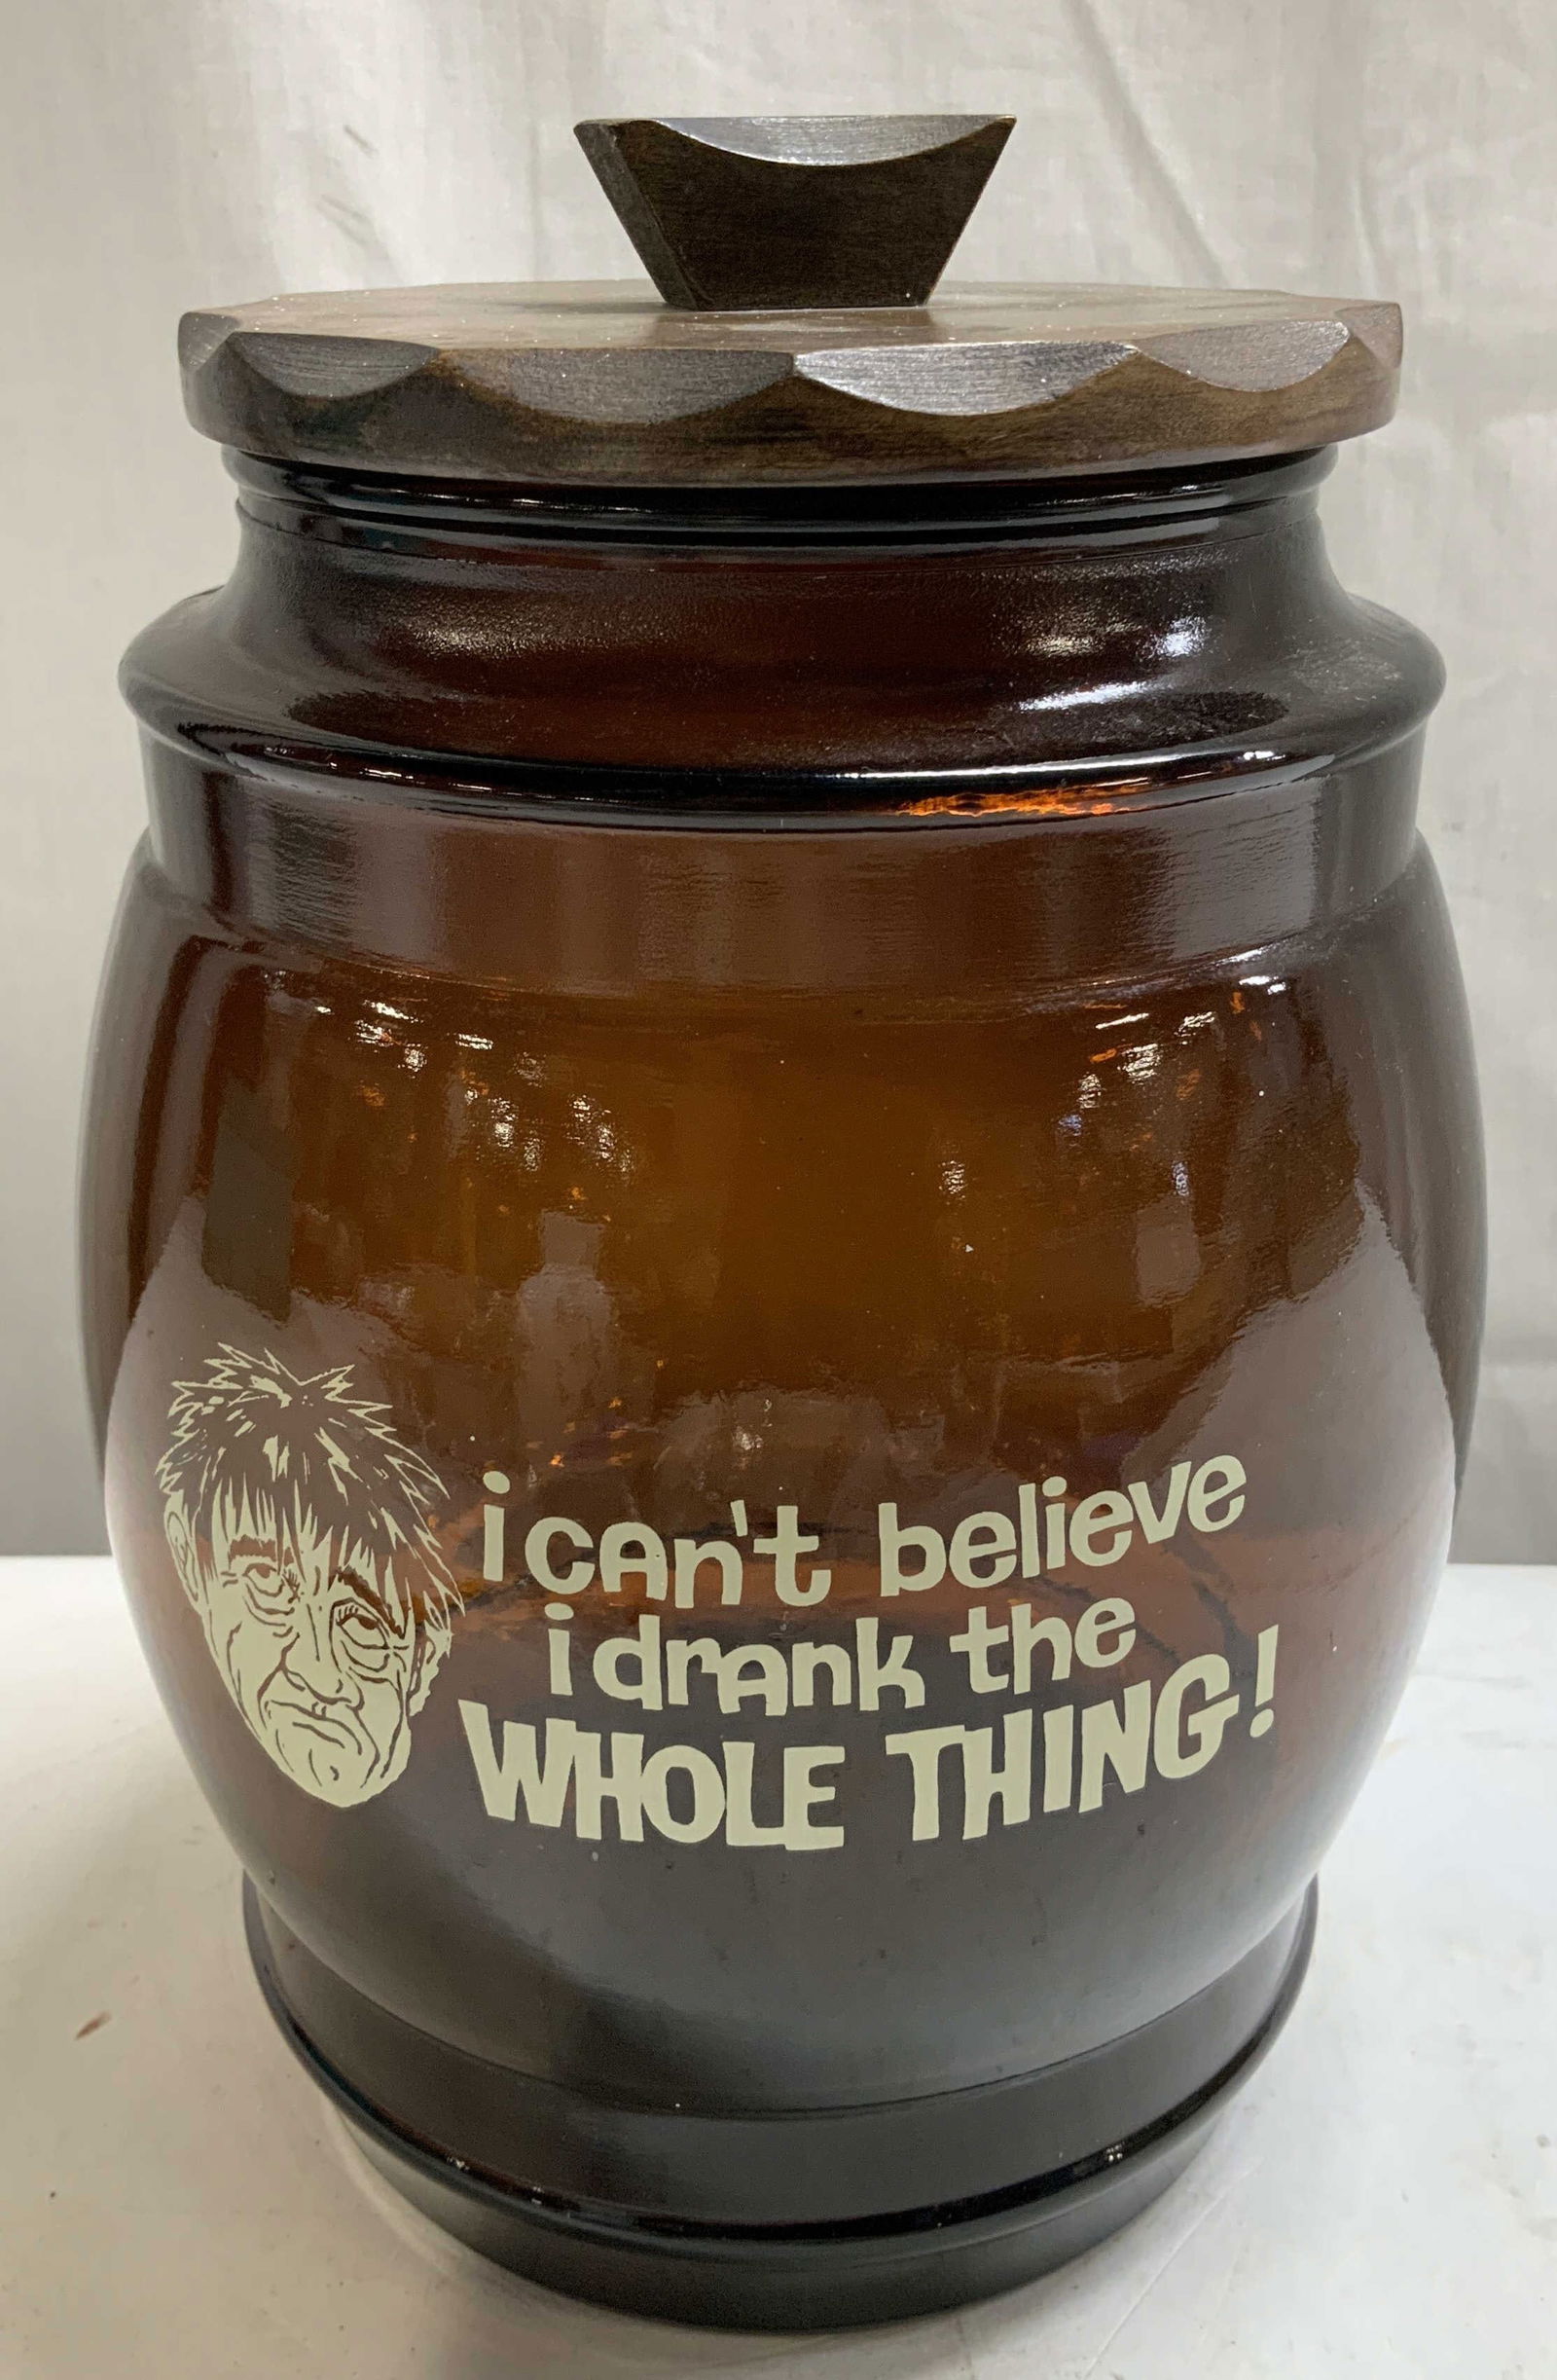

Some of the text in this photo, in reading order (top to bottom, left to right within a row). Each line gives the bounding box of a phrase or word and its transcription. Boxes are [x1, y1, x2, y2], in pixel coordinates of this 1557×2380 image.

[482, 1470, 511, 1583] i
[878, 1454, 1248, 1598] believe
[544, 1602, 575, 1697] i
[948, 1596, 1138, 1696] the
[457, 1624, 1280, 1851] WHOLE THING!
